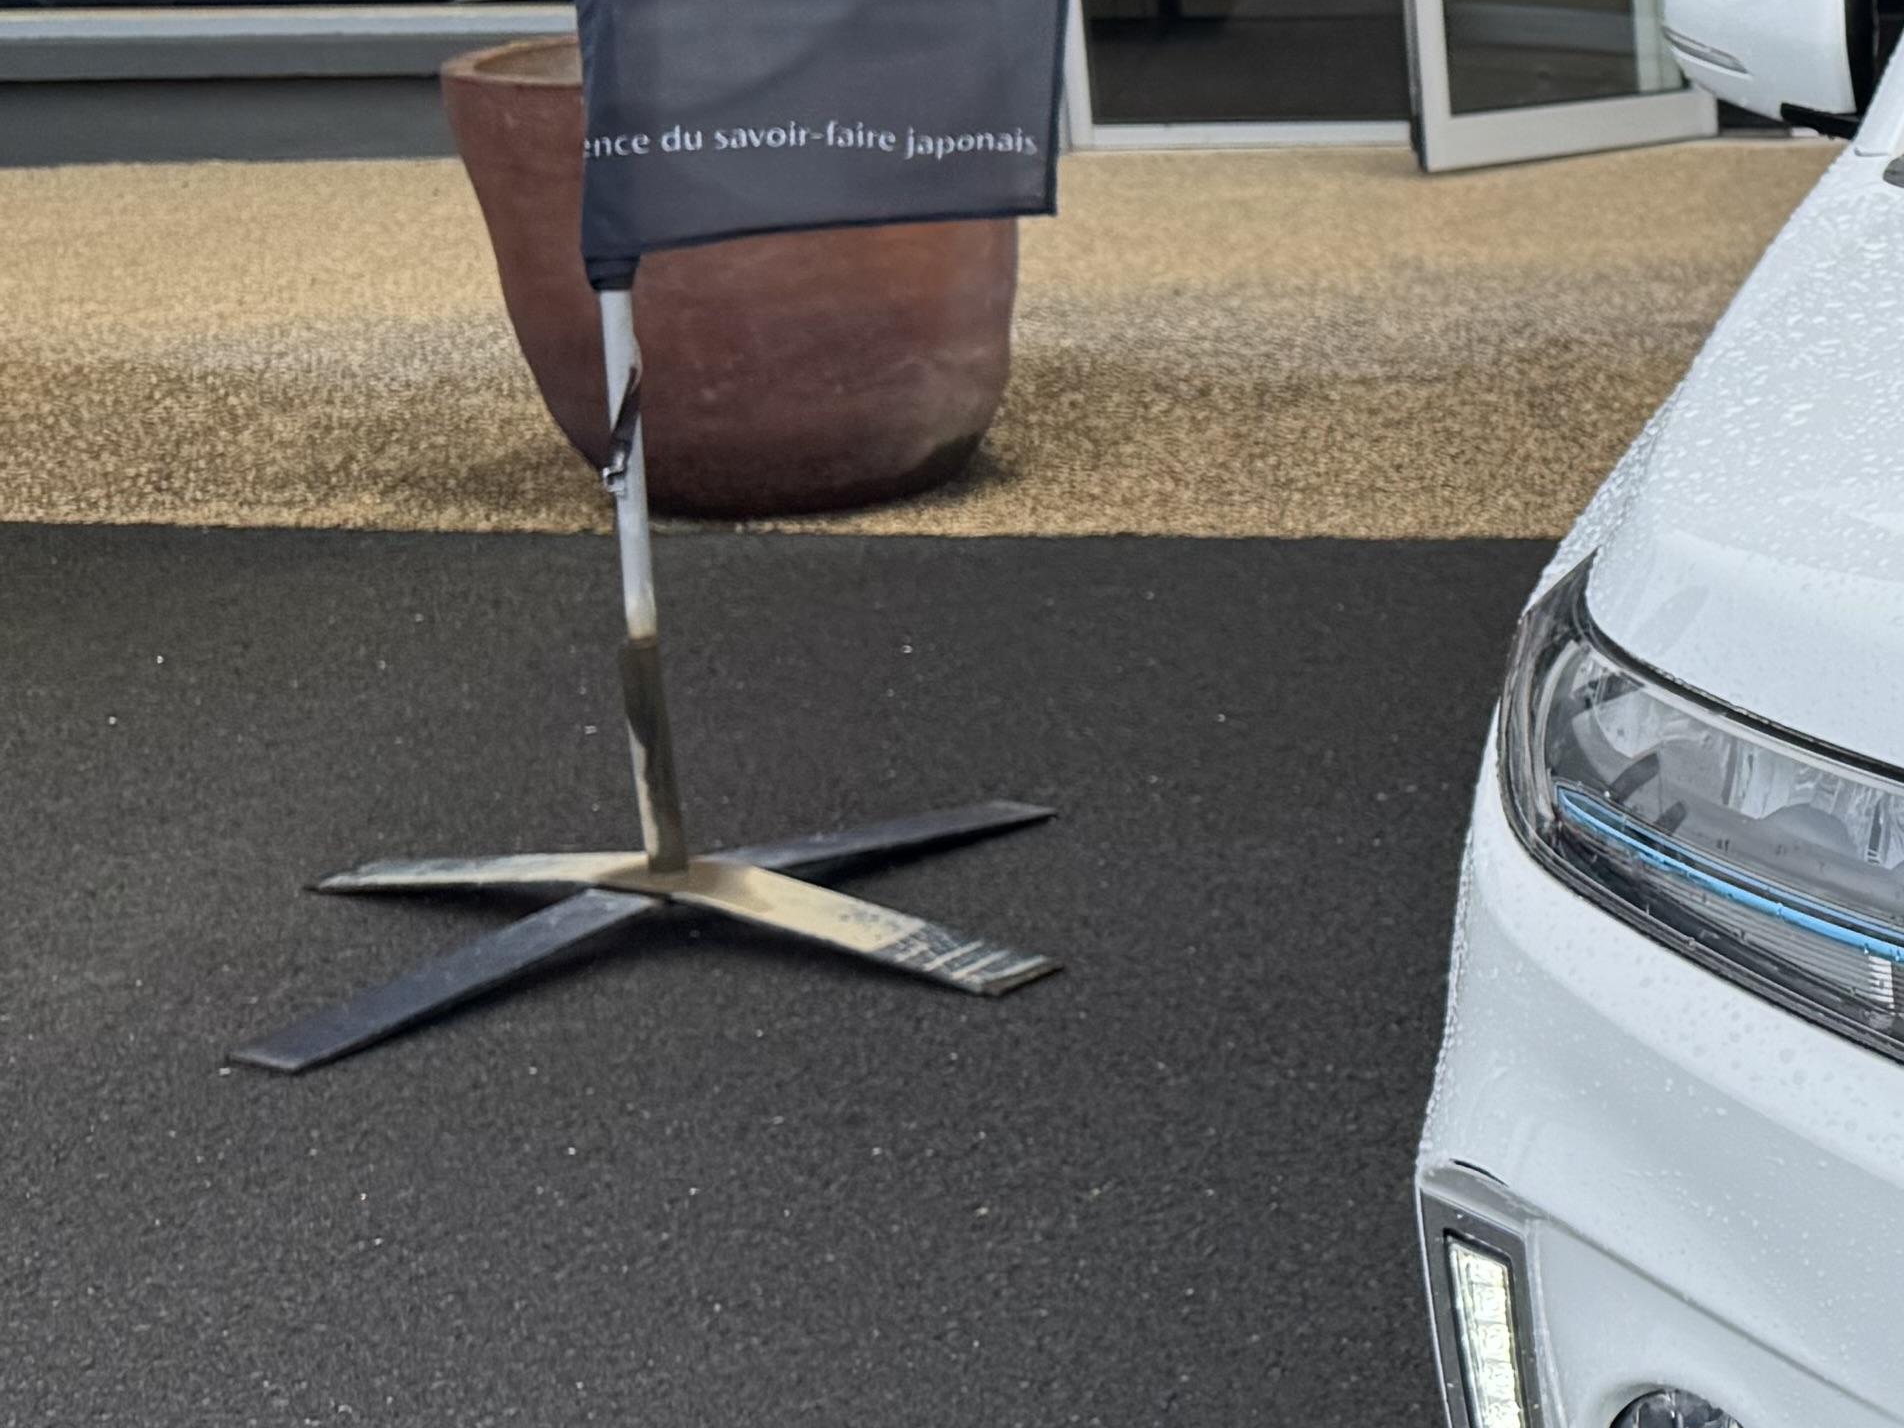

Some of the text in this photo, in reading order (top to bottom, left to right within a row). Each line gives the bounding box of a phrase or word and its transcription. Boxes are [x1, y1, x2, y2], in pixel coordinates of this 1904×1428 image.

[660, 124, 703, 153] du
[713, 121, 898, 153] savoir-faire
[904, 126, 1040, 160] japonais
